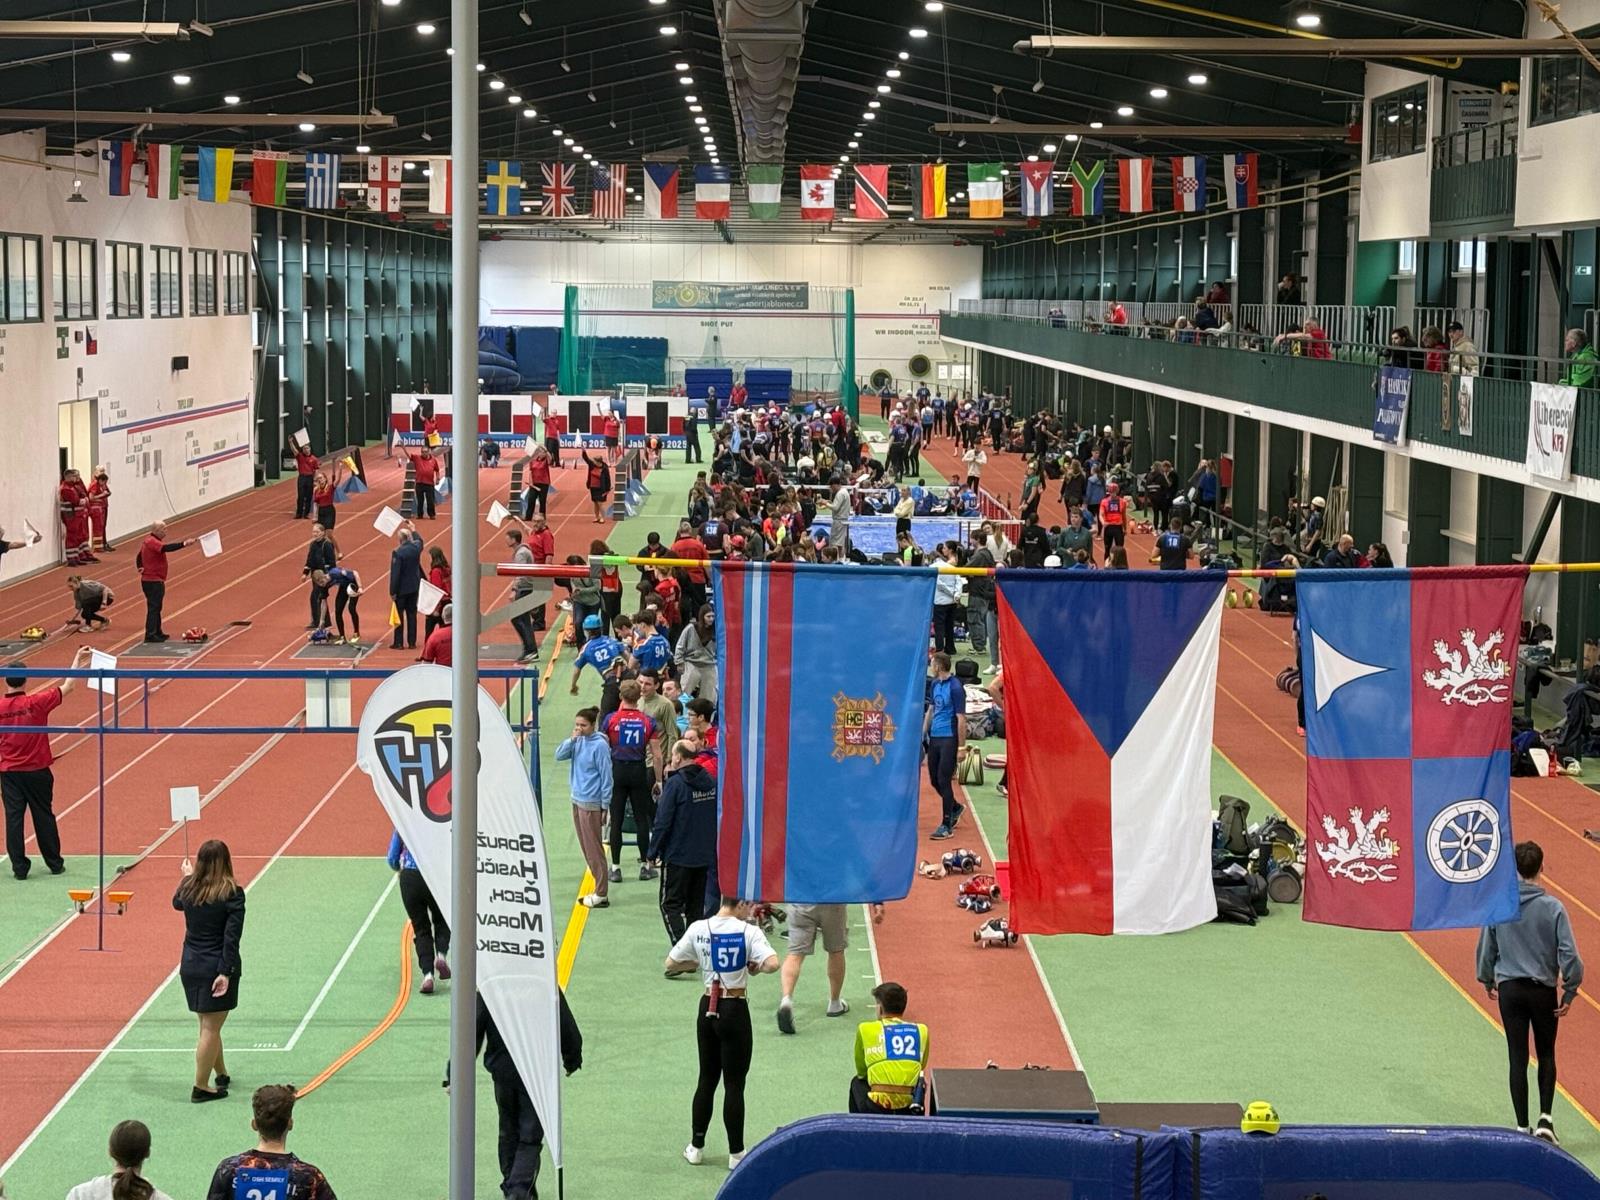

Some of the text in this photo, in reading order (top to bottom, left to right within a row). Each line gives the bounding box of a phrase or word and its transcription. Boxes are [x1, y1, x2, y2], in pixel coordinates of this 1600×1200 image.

[594, 648, 610, 662] 82
[654, 645, 665, 658] 94
[624, 730, 640, 744] 71
[718, 946, 740, 968] 57
[891, 1035, 916, 1056] 92
